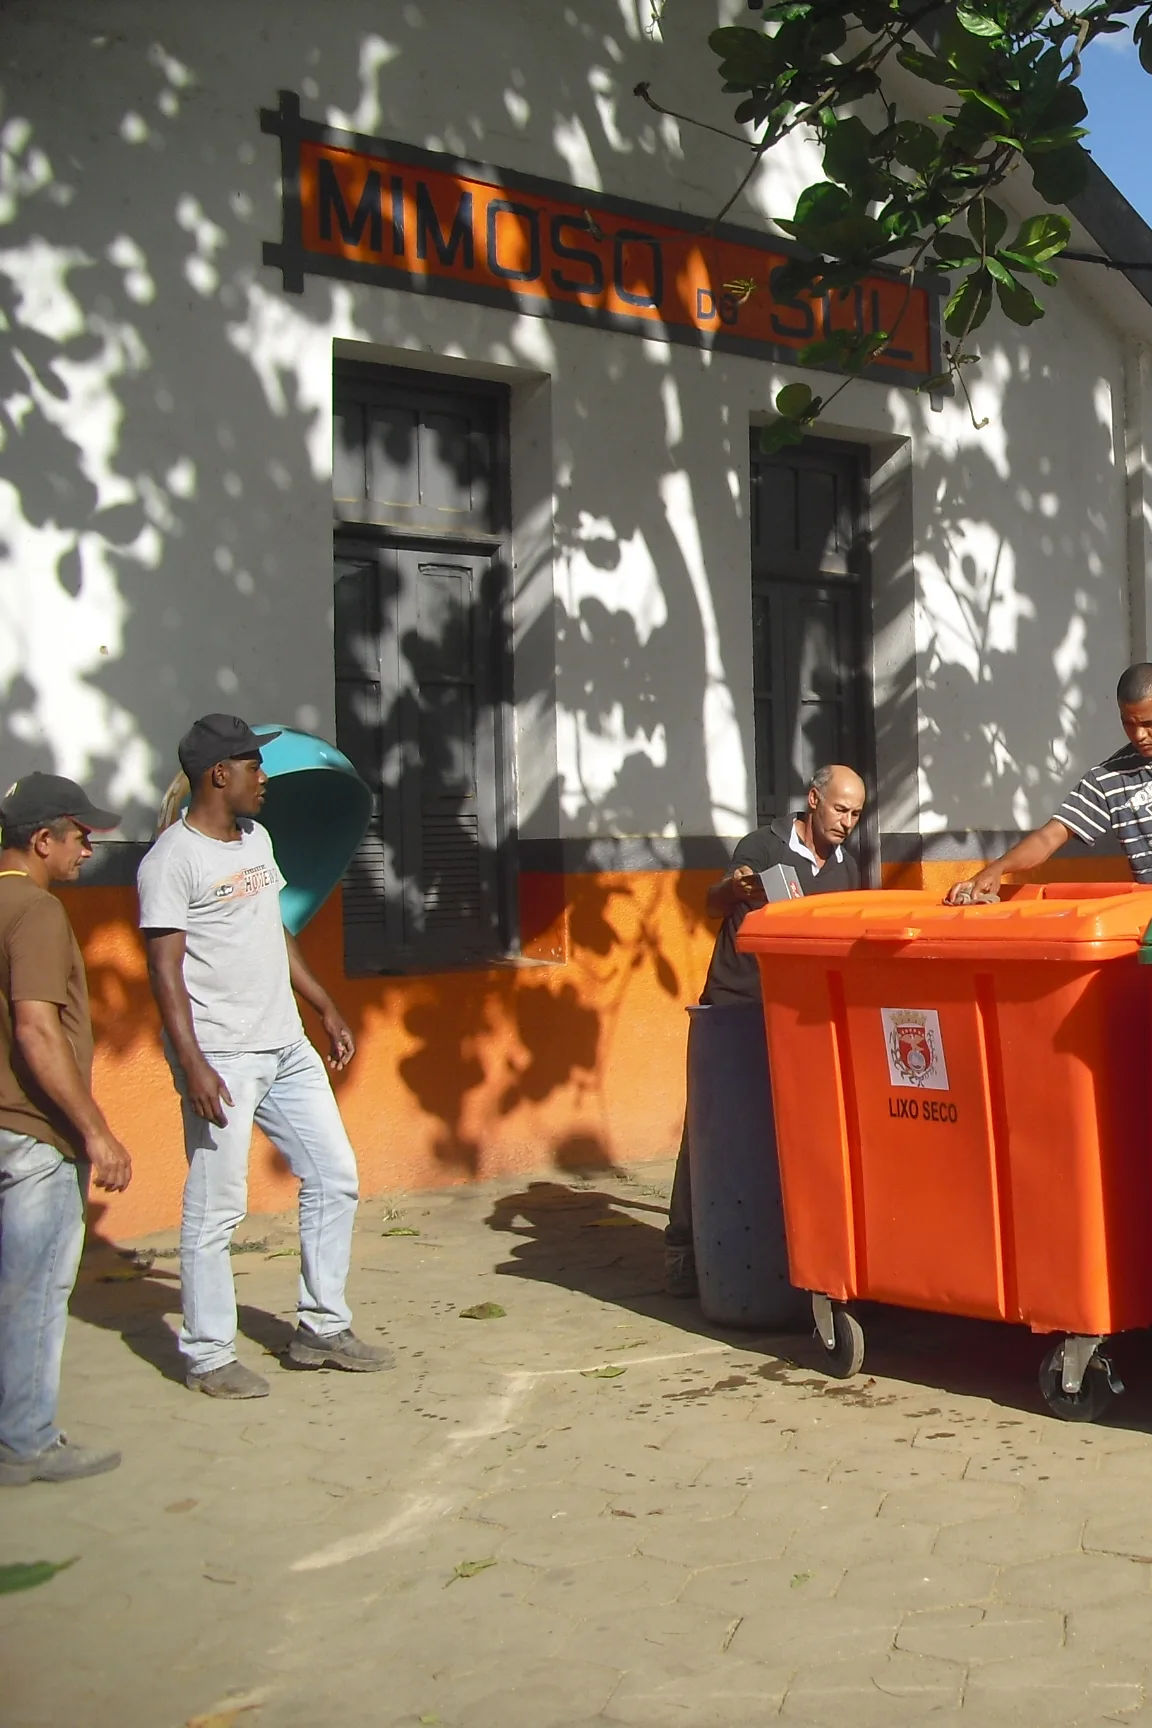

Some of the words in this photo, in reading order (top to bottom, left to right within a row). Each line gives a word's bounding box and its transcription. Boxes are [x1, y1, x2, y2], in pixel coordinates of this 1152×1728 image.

[318, 159, 664, 309] MIMOSO
[888, 1098, 919, 1119] LIXO
[922, 1100, 958, 1124] SECO
